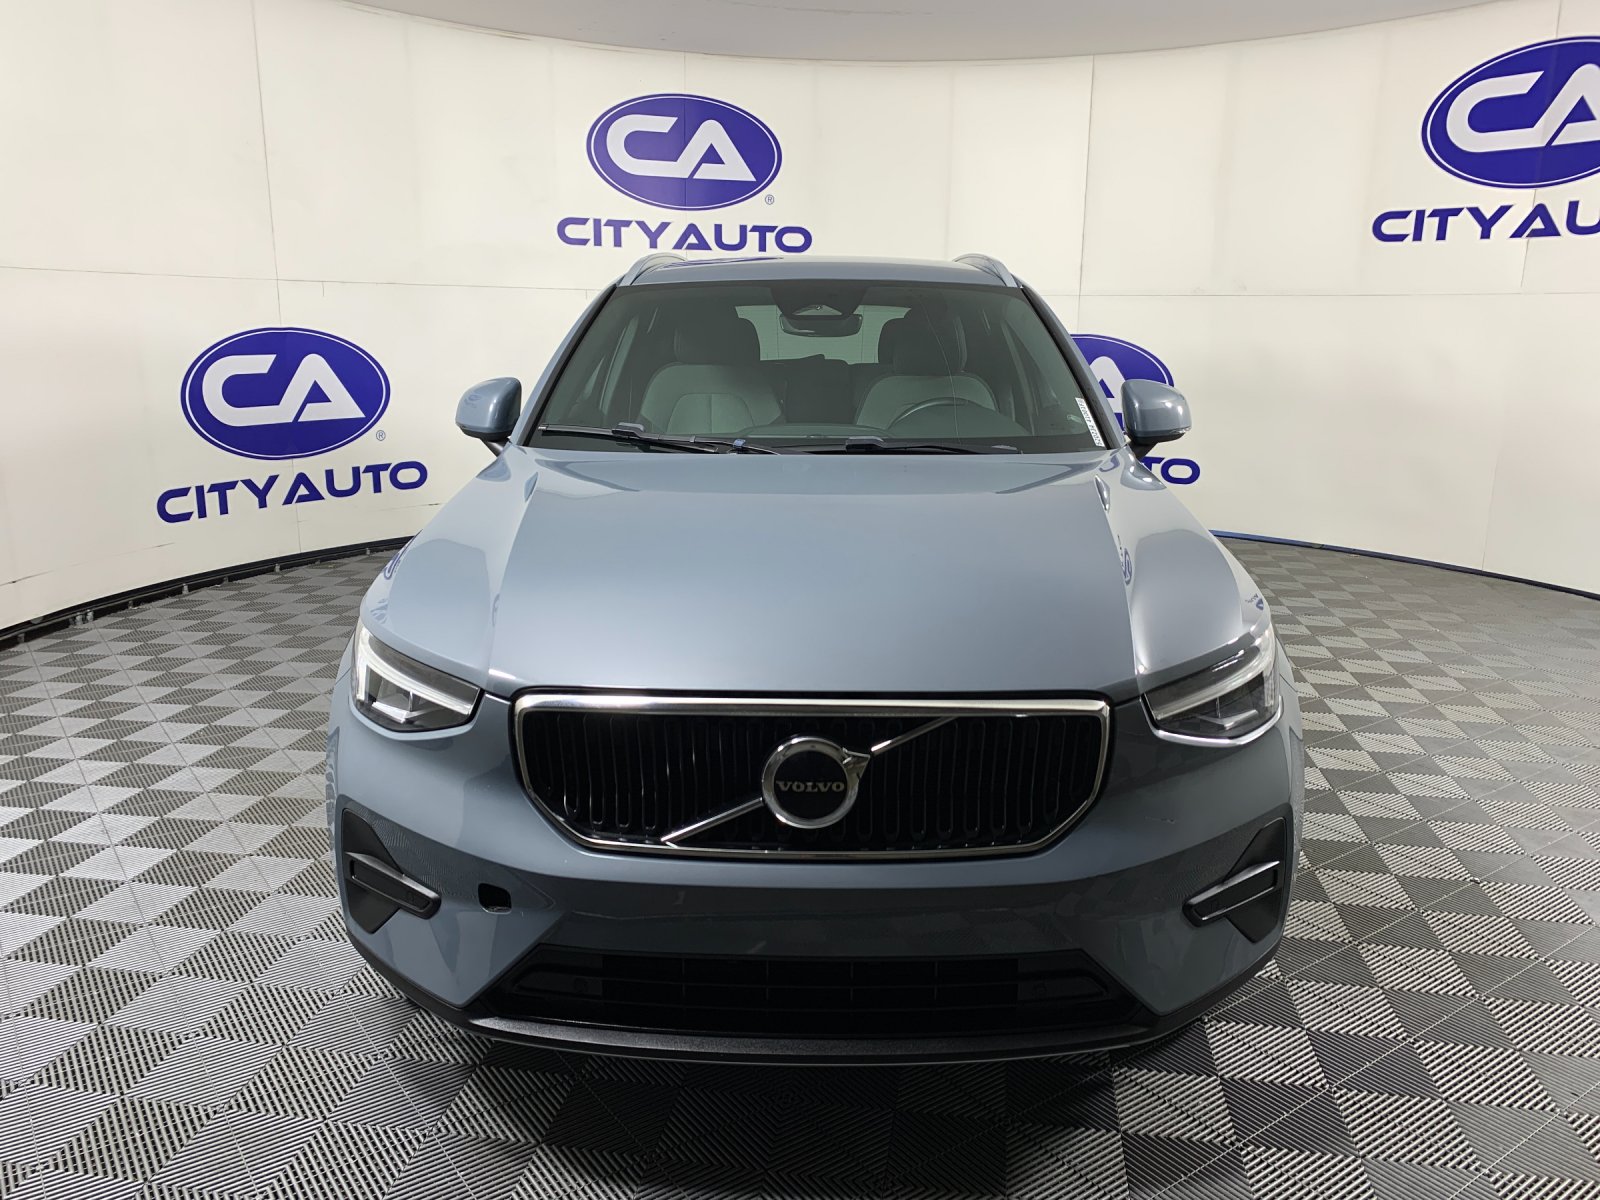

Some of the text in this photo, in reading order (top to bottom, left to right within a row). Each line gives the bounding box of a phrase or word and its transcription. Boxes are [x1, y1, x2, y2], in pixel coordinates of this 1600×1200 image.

[1446, 63, 1600, 153] CA
[606, 113, 757, 182] CA
[556, 217, 813, 253] CITY AUTO
[1372, 200, 1600, 242] CITY AU
[202, 353, 366, 427] CA
[156, 460, 428, 524] CITY AUTO
[776, 781, 845, 793] VOLVO
